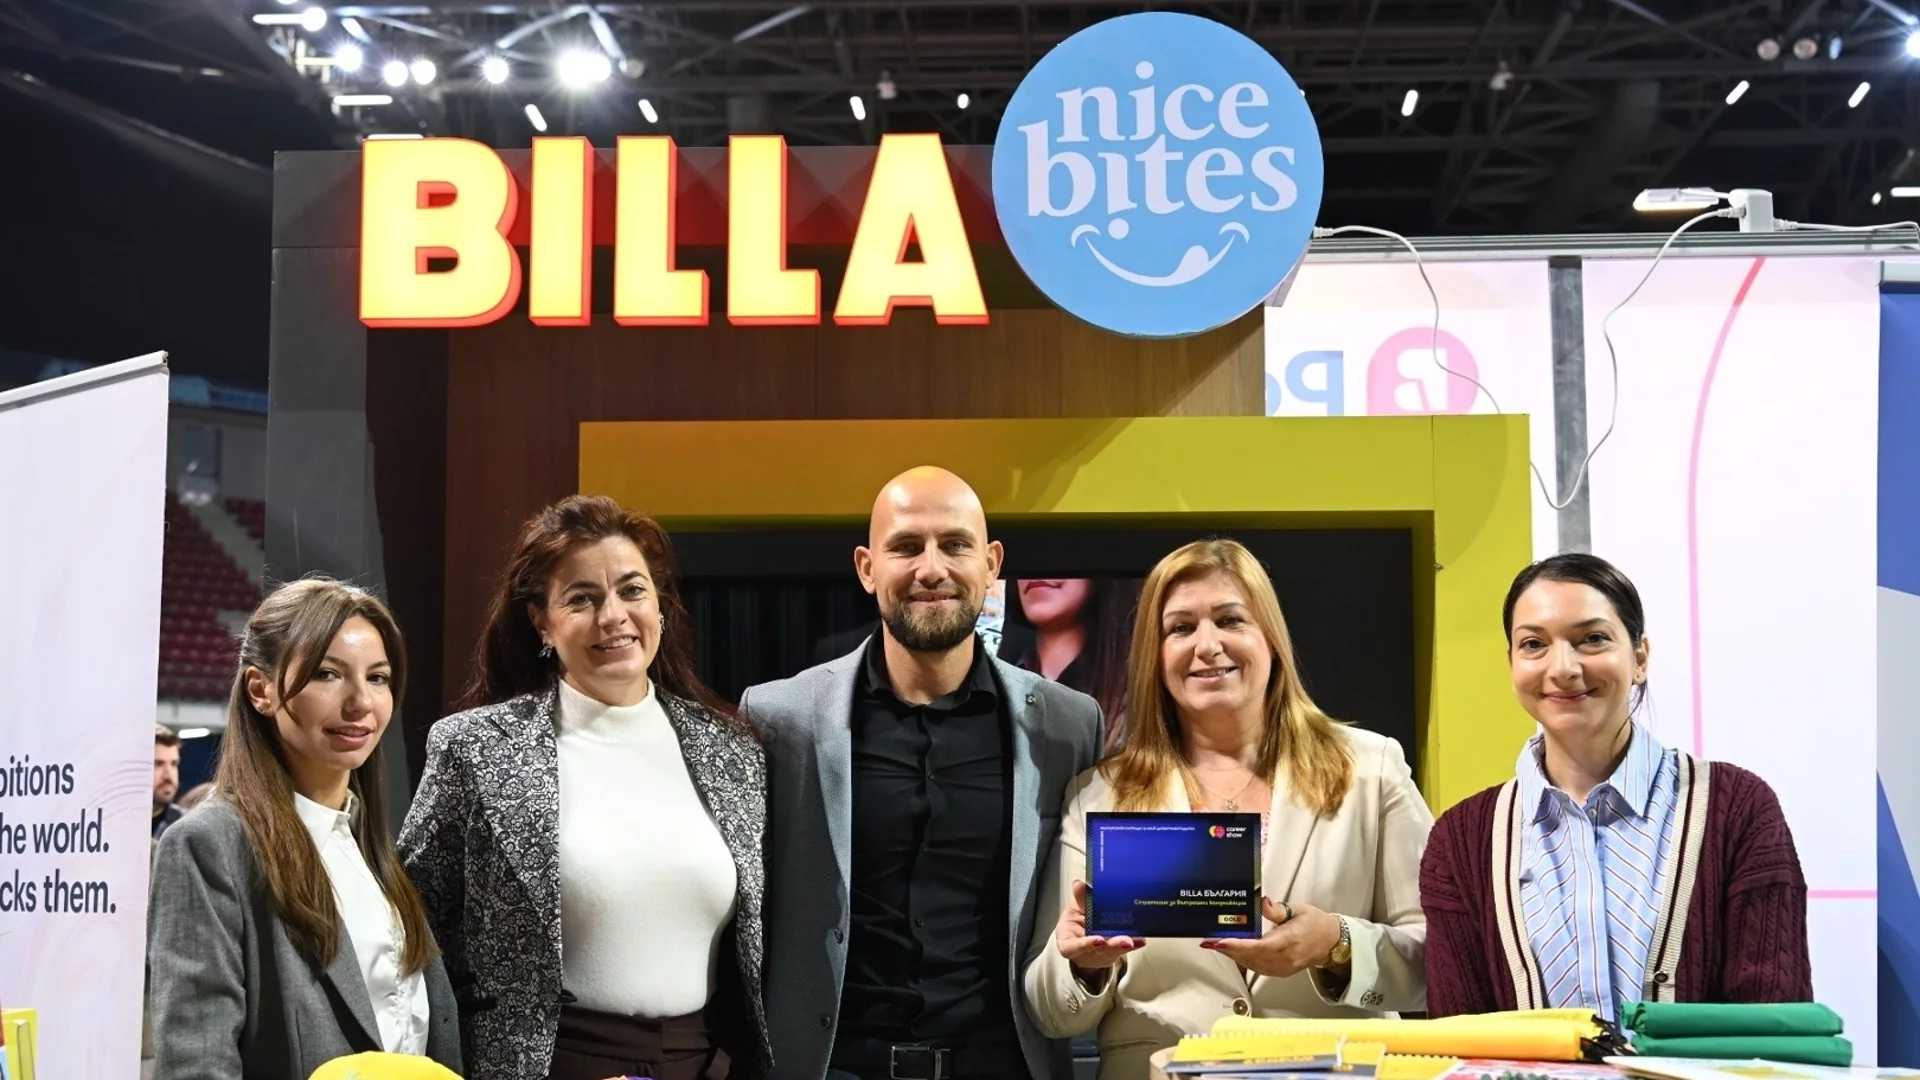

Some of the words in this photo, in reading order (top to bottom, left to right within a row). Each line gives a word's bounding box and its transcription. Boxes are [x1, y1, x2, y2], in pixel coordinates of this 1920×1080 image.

[1055, 61, 1269, 142] nice
[1018, 120, 1298, 217] bites
[359, 132, 990, 328] BILLA
[33, 808, 109, 853] world.
[0, 869, 36, 912] cks
[44, 868, 116, 914] them.
[1180, 889, 1203, 897] BILLA
[1204, 889, 1247, 897] БЪЛГАРИЯ
